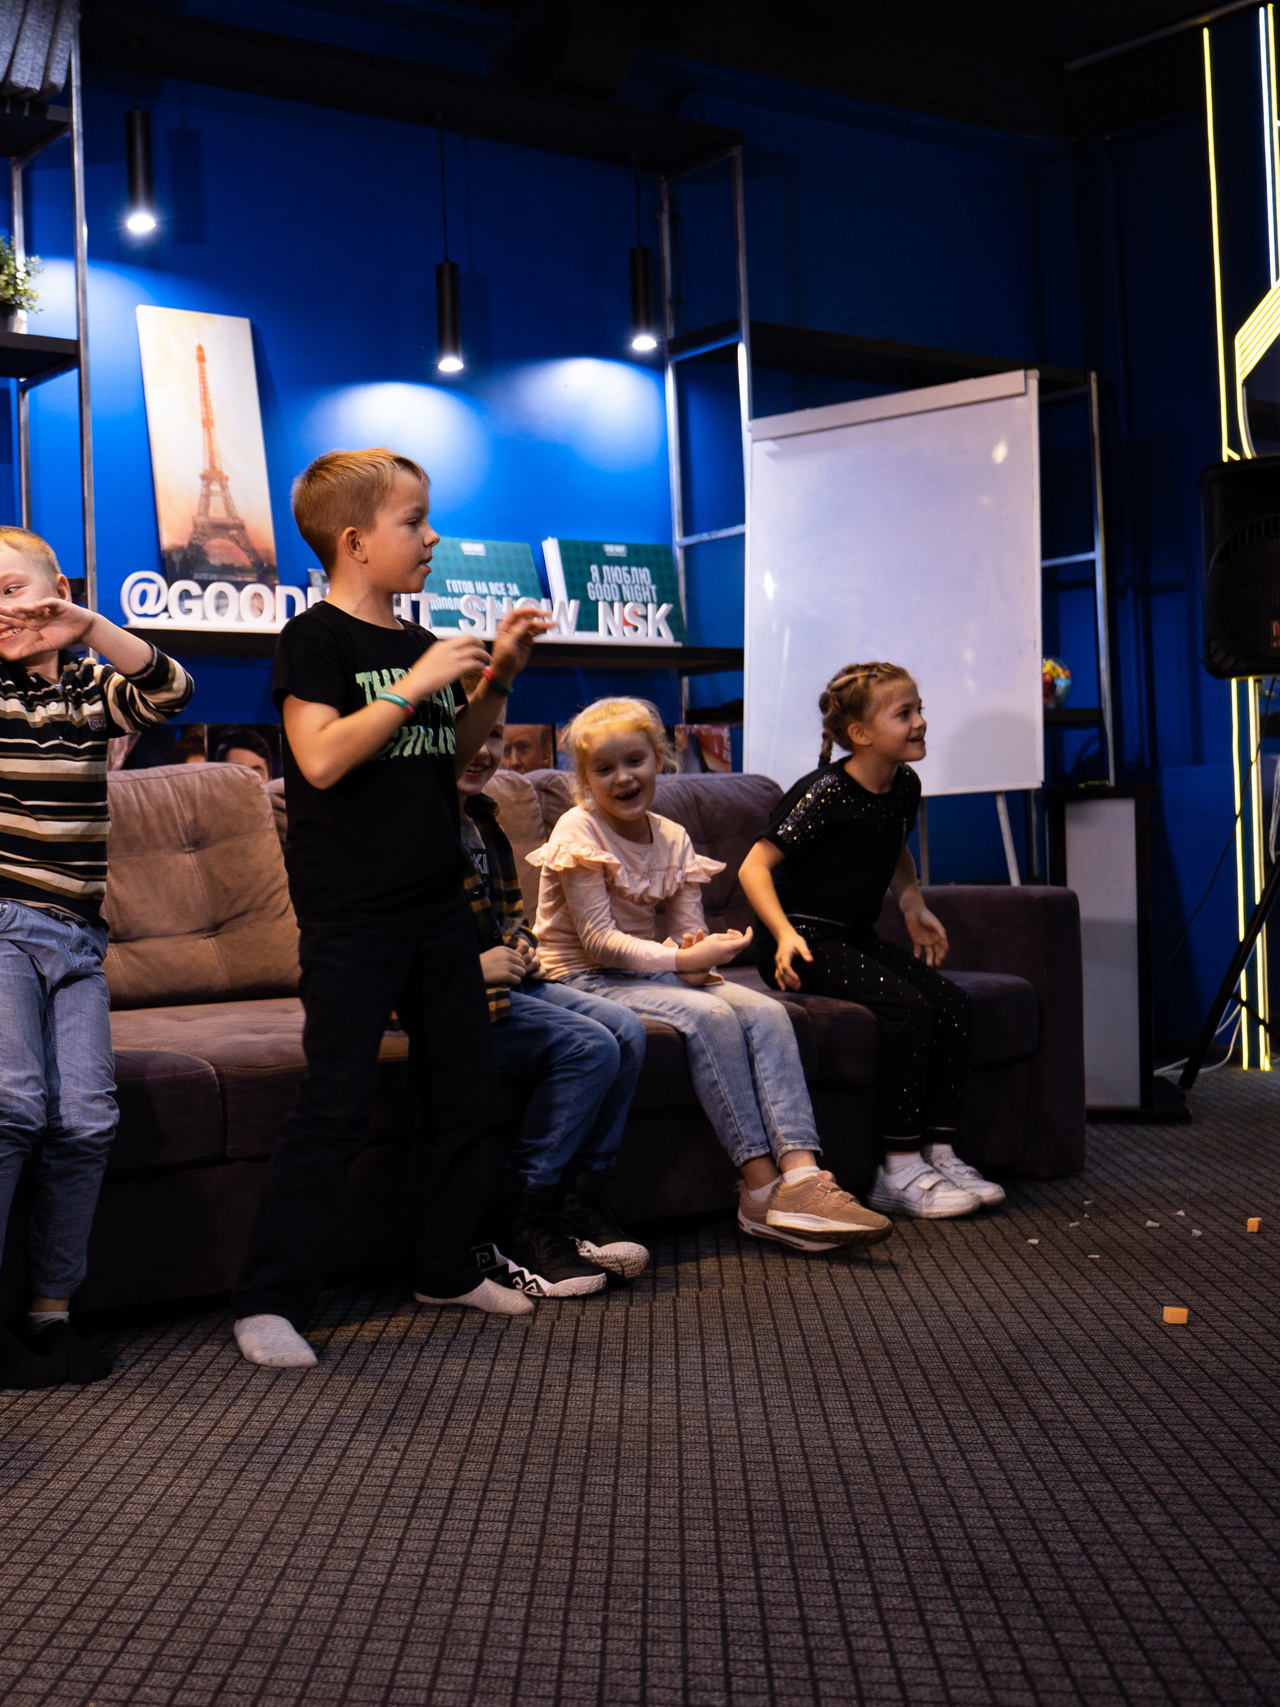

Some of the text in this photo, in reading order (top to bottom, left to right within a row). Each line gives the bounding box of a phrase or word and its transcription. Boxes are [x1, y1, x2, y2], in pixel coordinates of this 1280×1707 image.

[590, 564, 652, 586] Я ЛЮБЛЮ
[446, 579, 520, 596] ГОТОВ НА ВСЕ ЗА
[587, 581, 657, 603] GOOD NIGHT
[598, 600, 674, 642] NSK
